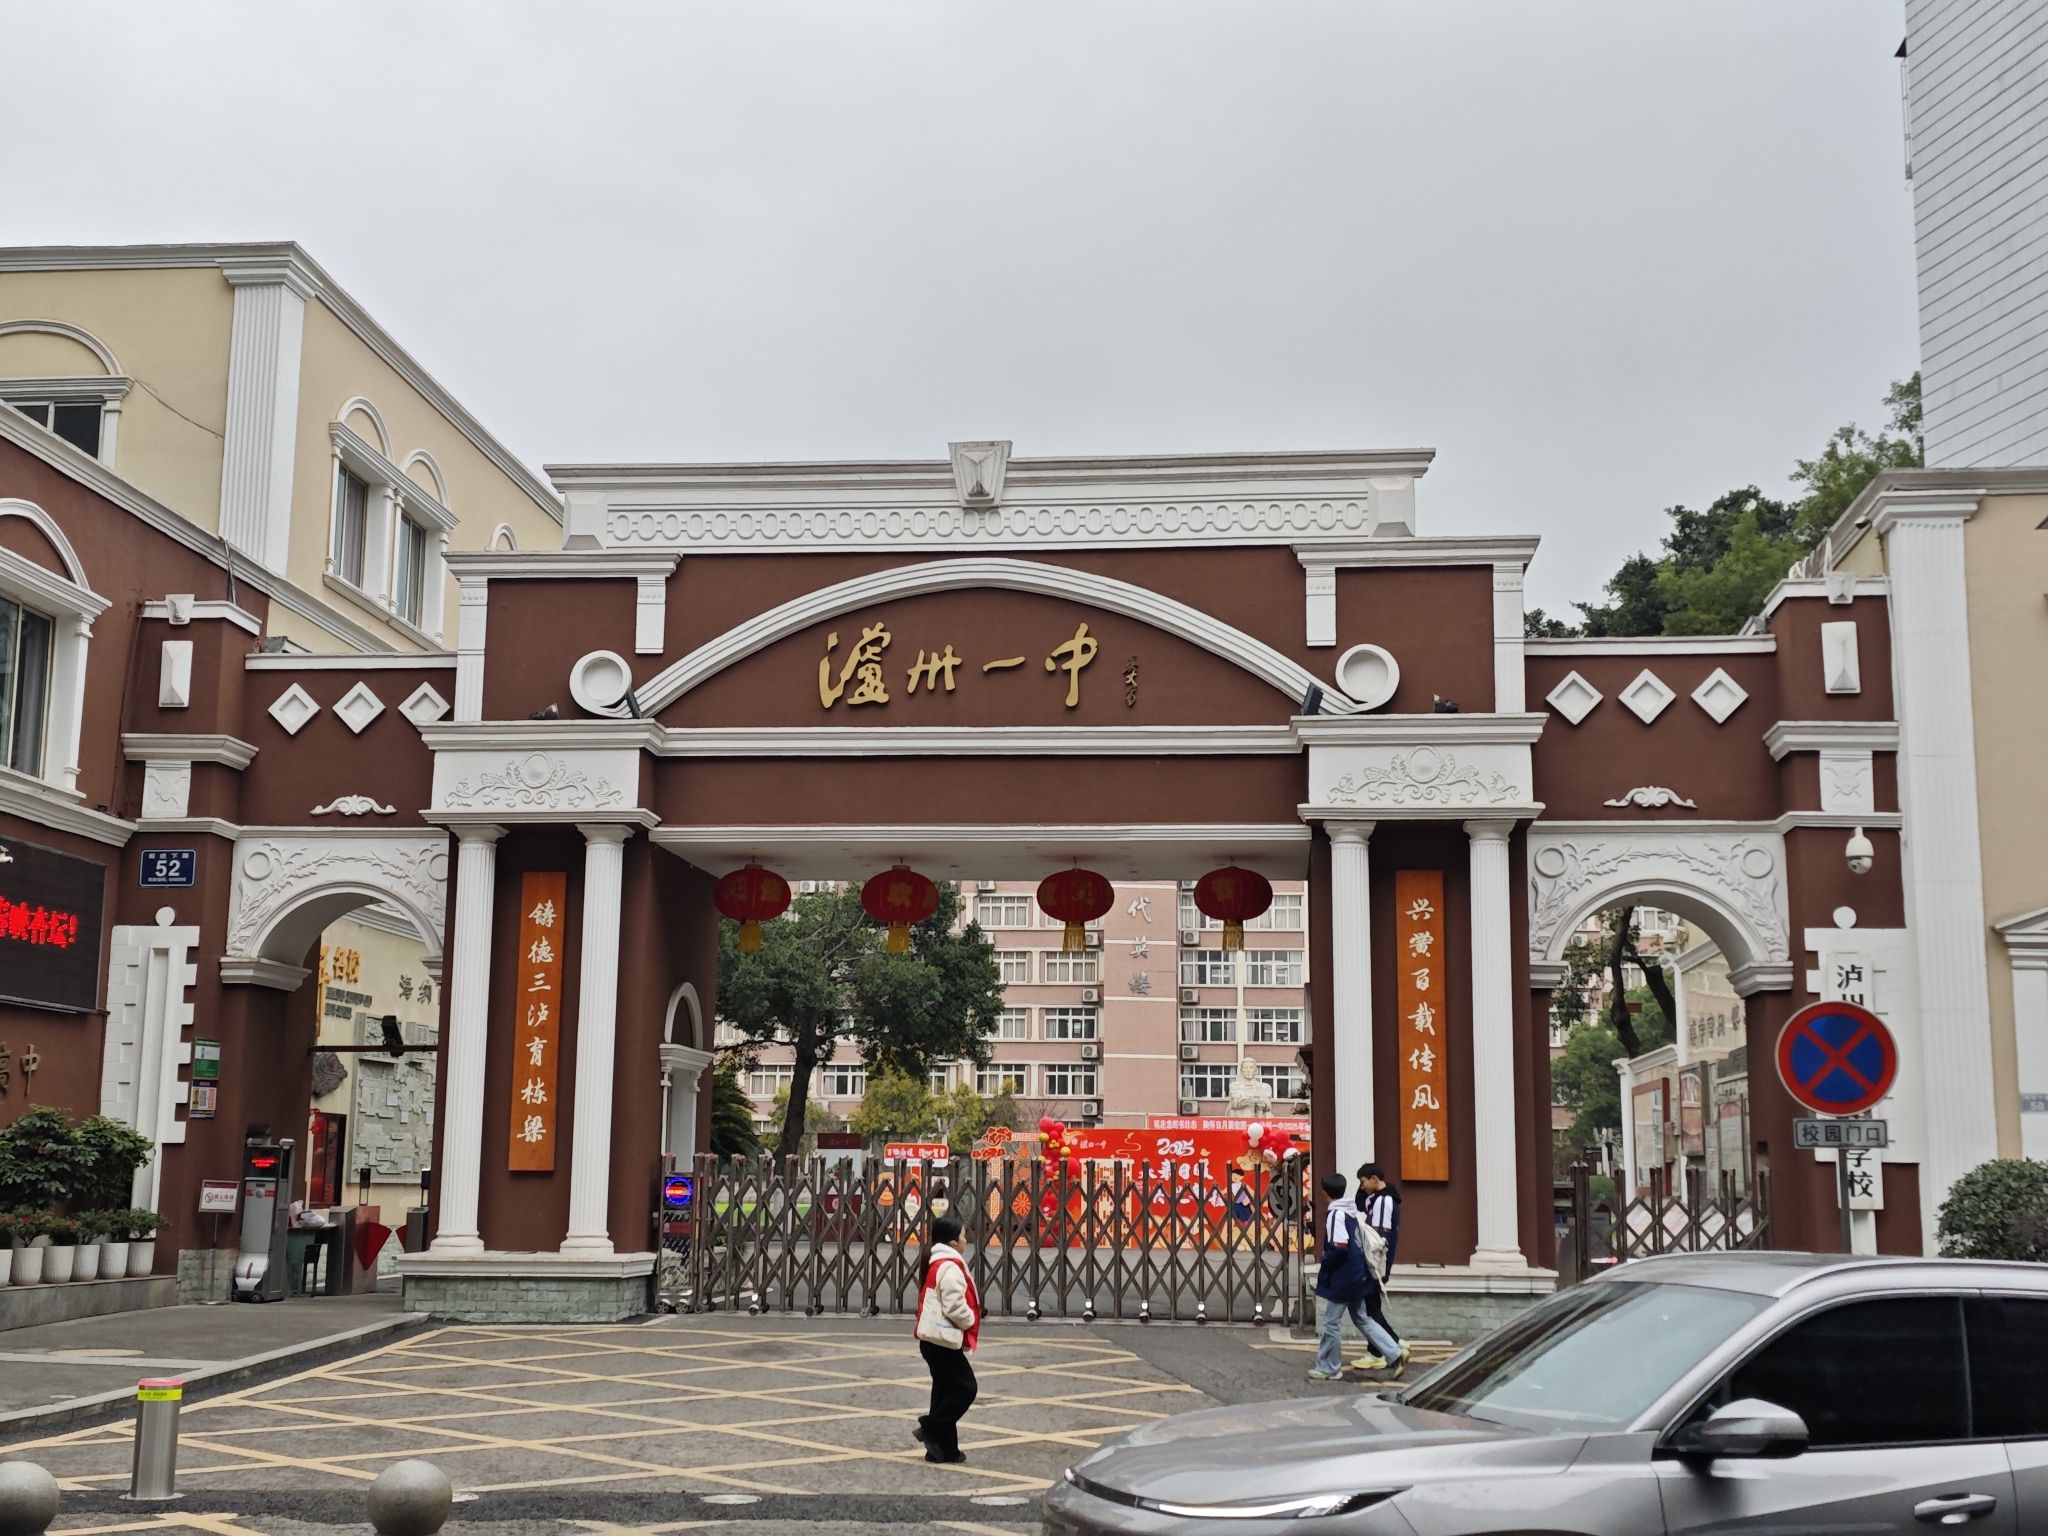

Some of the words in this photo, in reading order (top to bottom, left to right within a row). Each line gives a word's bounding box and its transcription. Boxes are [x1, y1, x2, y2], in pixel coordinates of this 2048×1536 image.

[155, 859, 181, 877] 52
[516, 900, 558, 1143] 铸德三泸育栋梁
[1802, 1124, 1882, 1144] 校园门口
[1156, 1137, 1196, 1158] 2025
